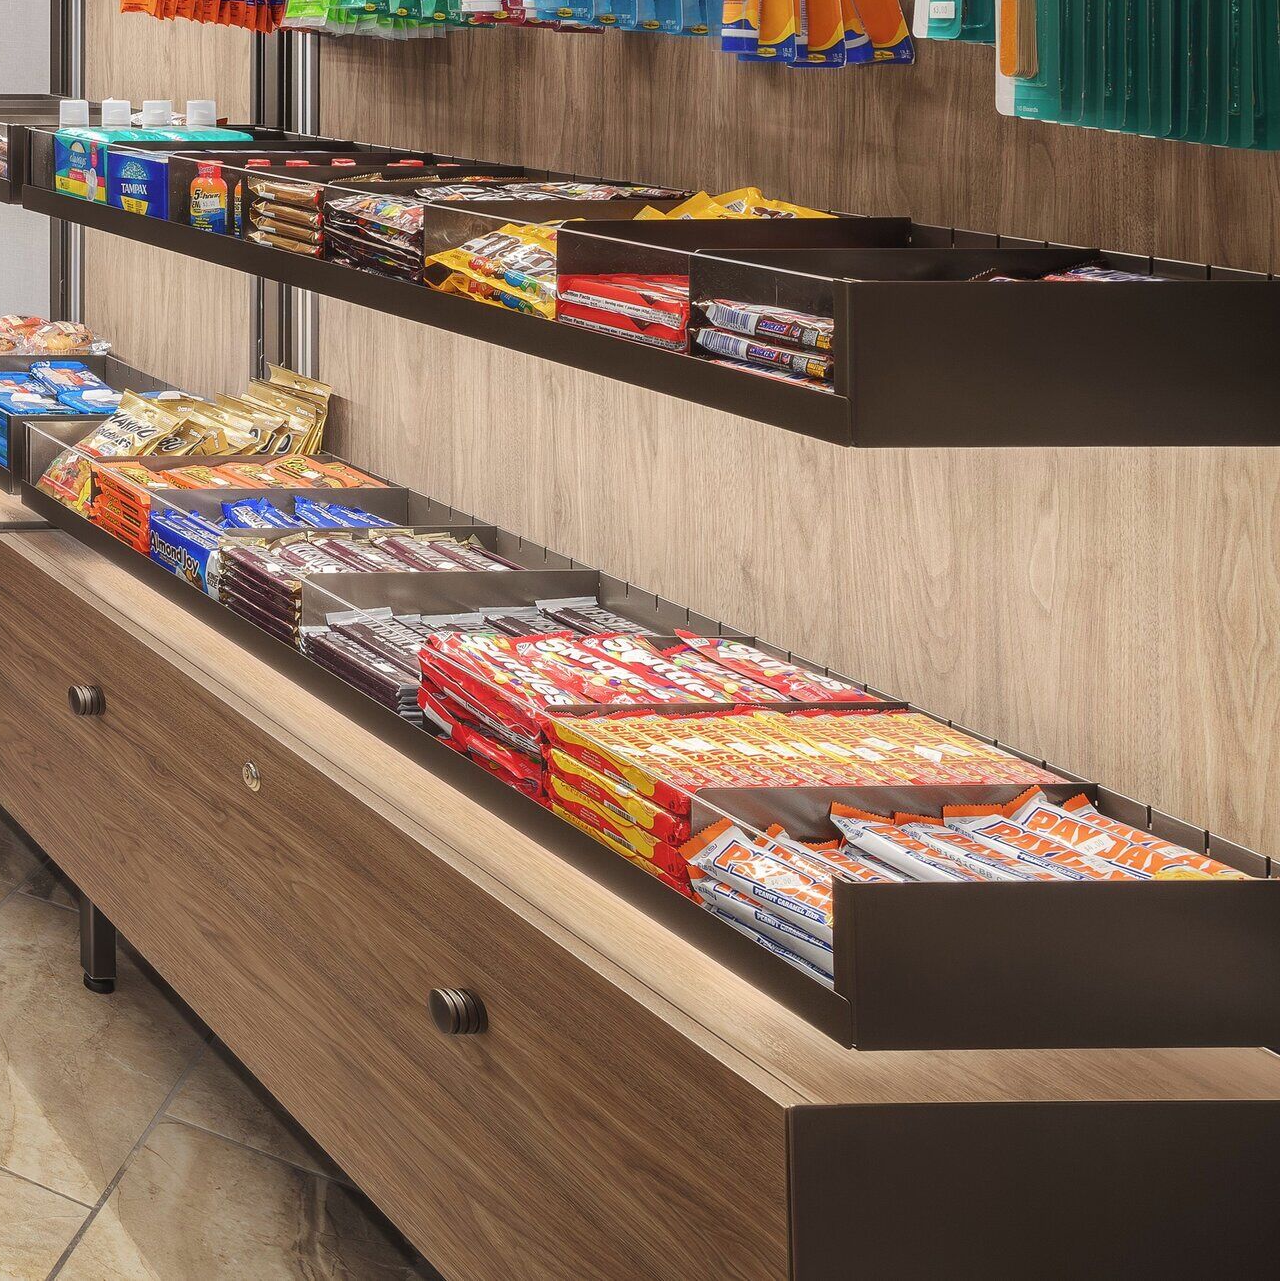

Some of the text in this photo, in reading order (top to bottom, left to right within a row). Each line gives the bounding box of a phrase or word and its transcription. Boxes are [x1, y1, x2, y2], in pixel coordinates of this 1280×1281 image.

[121, 183, 147, 195] TAMPAX
[193, 188, 220, 201] 5-hour
[747, 346, 779, 361] SNICKERS
[151, 529, 200, 576] Almond Joy
[755, 888, 778, 903] PEANUT
[777, 898, 805, 915] CARAMEL
